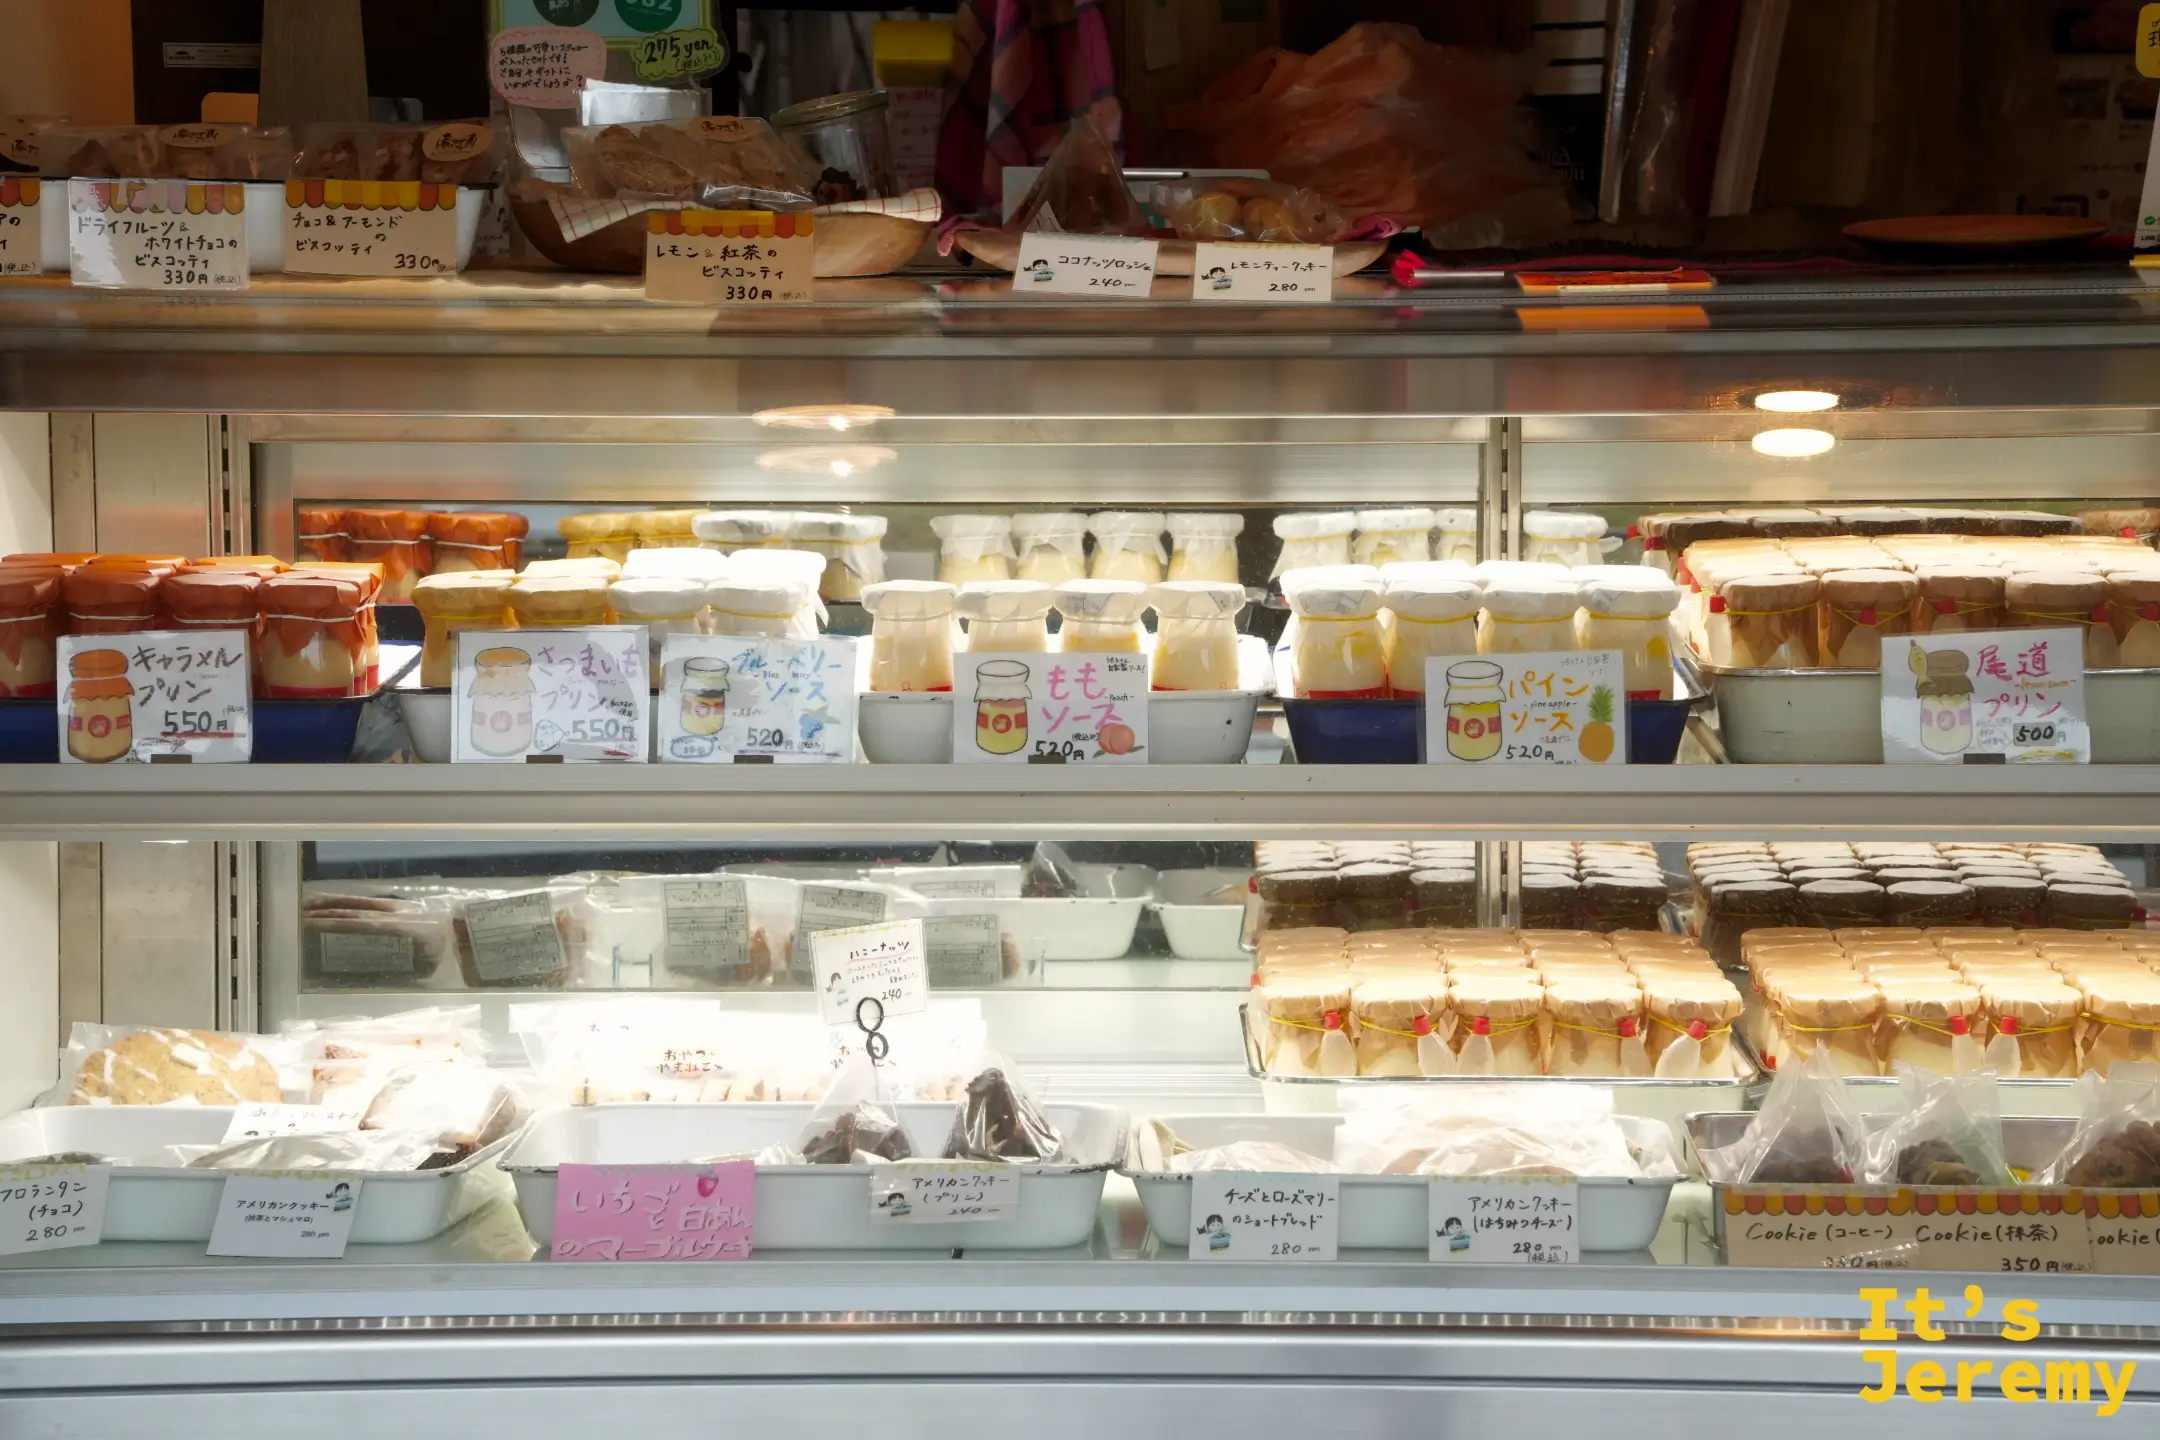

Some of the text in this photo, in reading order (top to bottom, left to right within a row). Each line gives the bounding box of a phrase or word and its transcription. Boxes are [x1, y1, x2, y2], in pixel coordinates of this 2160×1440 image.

[645, 36, 713, 63] 275 yen
[144, 235, 238, 251] ホワイトチョコの
[296, 238, 372, 255] ビスコッティ
[135, 254, 209, 269] ビスコッティ
[1058, 255, 1152, 271] ココナッツロッシェ
[1230, 261, 1328, 271] レモンティークッキー
[702, 265, 784, 280] ビスコッティ
[1089, 278, 1122, 288] 240
[1268, 282, 1298, 293] 280
[725, 286, 772, 300] 330円
[132, 645, 243, 672] キャラメル
[538, 643, 640, 677] さつまいも
[731, 644, 842, 674] ブルーベリー
[1975, 641, 2051, 681] 尾道
[1047, 662, 1107, 701] もも
[1509, 670, 1589, 699] パイン
[139, 678, 213, 707] プリン
[541, 684, 608, 713] プリン
[765, 681, 828, 702] ソース
[1983, 692, 2063, 719] プリン
[1041, 703, 1123, 734] ソース
[1510, 710, 1575, 733] ソース
[1035, 740, 1085, 761] 520円
[1505, 744, 1554, 760] 520円
[850, 941, 910, 960] ハニーナッツ
[881, 988, 902, 1001] 240
[0, 1181, 87, 1202] フロランタン
[912, 1175, 1010, 1190] アメリカンクッキー
[236, 1200, 329, 1211] アメリカンクッキー
[571, 1180, 682, 1216] いちご
[923, 1191, 984, 1203] (プリン)
[1224, 1188, 1335, 1207] チーズとローズマリー
[1468, 1196, 1573, 1212] アメリカンクッキー
[29, 1200, 84, 1221] (チョコ)
[948, 1207, 982, 1216] 240
[1232, 1212, 1323, 1230] のショートブレッド
[1473, 1215, 1573, 1233] (はちみつチーズ)
[25, 1225, 67, 1241] 280
[300, 1230, 316, 1238] 280
[1745, 1222, 1818, 1242] Cookie
[1915, 1222, 1993, 1243] Cookie
[1271, 1243, 1302, 1256] 280
[1512, 1242, 1543, 1254] 280
[1527, 1251, 1569, 1263] (税込)
